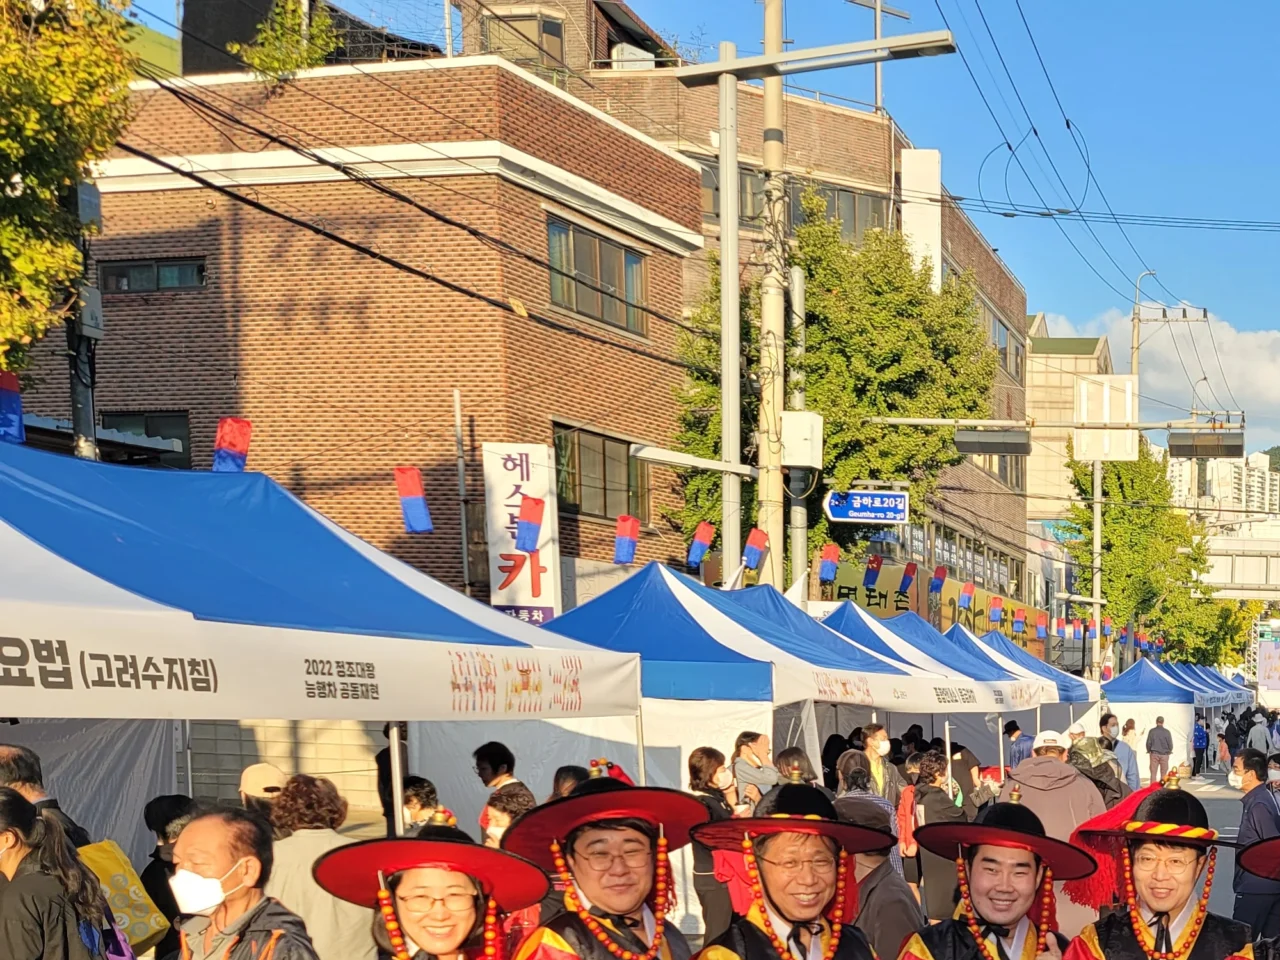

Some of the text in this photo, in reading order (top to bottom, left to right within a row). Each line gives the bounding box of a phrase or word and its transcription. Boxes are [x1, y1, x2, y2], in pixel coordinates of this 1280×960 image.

[851, 496, 905, 509] 금하로20길
[848, 510, 885, 519] Geumha-ro
[0, 636, 218, 693] 요법 (고려수지침)
[304, 658, 375, 679] 2022 정조대왕
[304, 679, 380, 700] 능행차 공동재현
